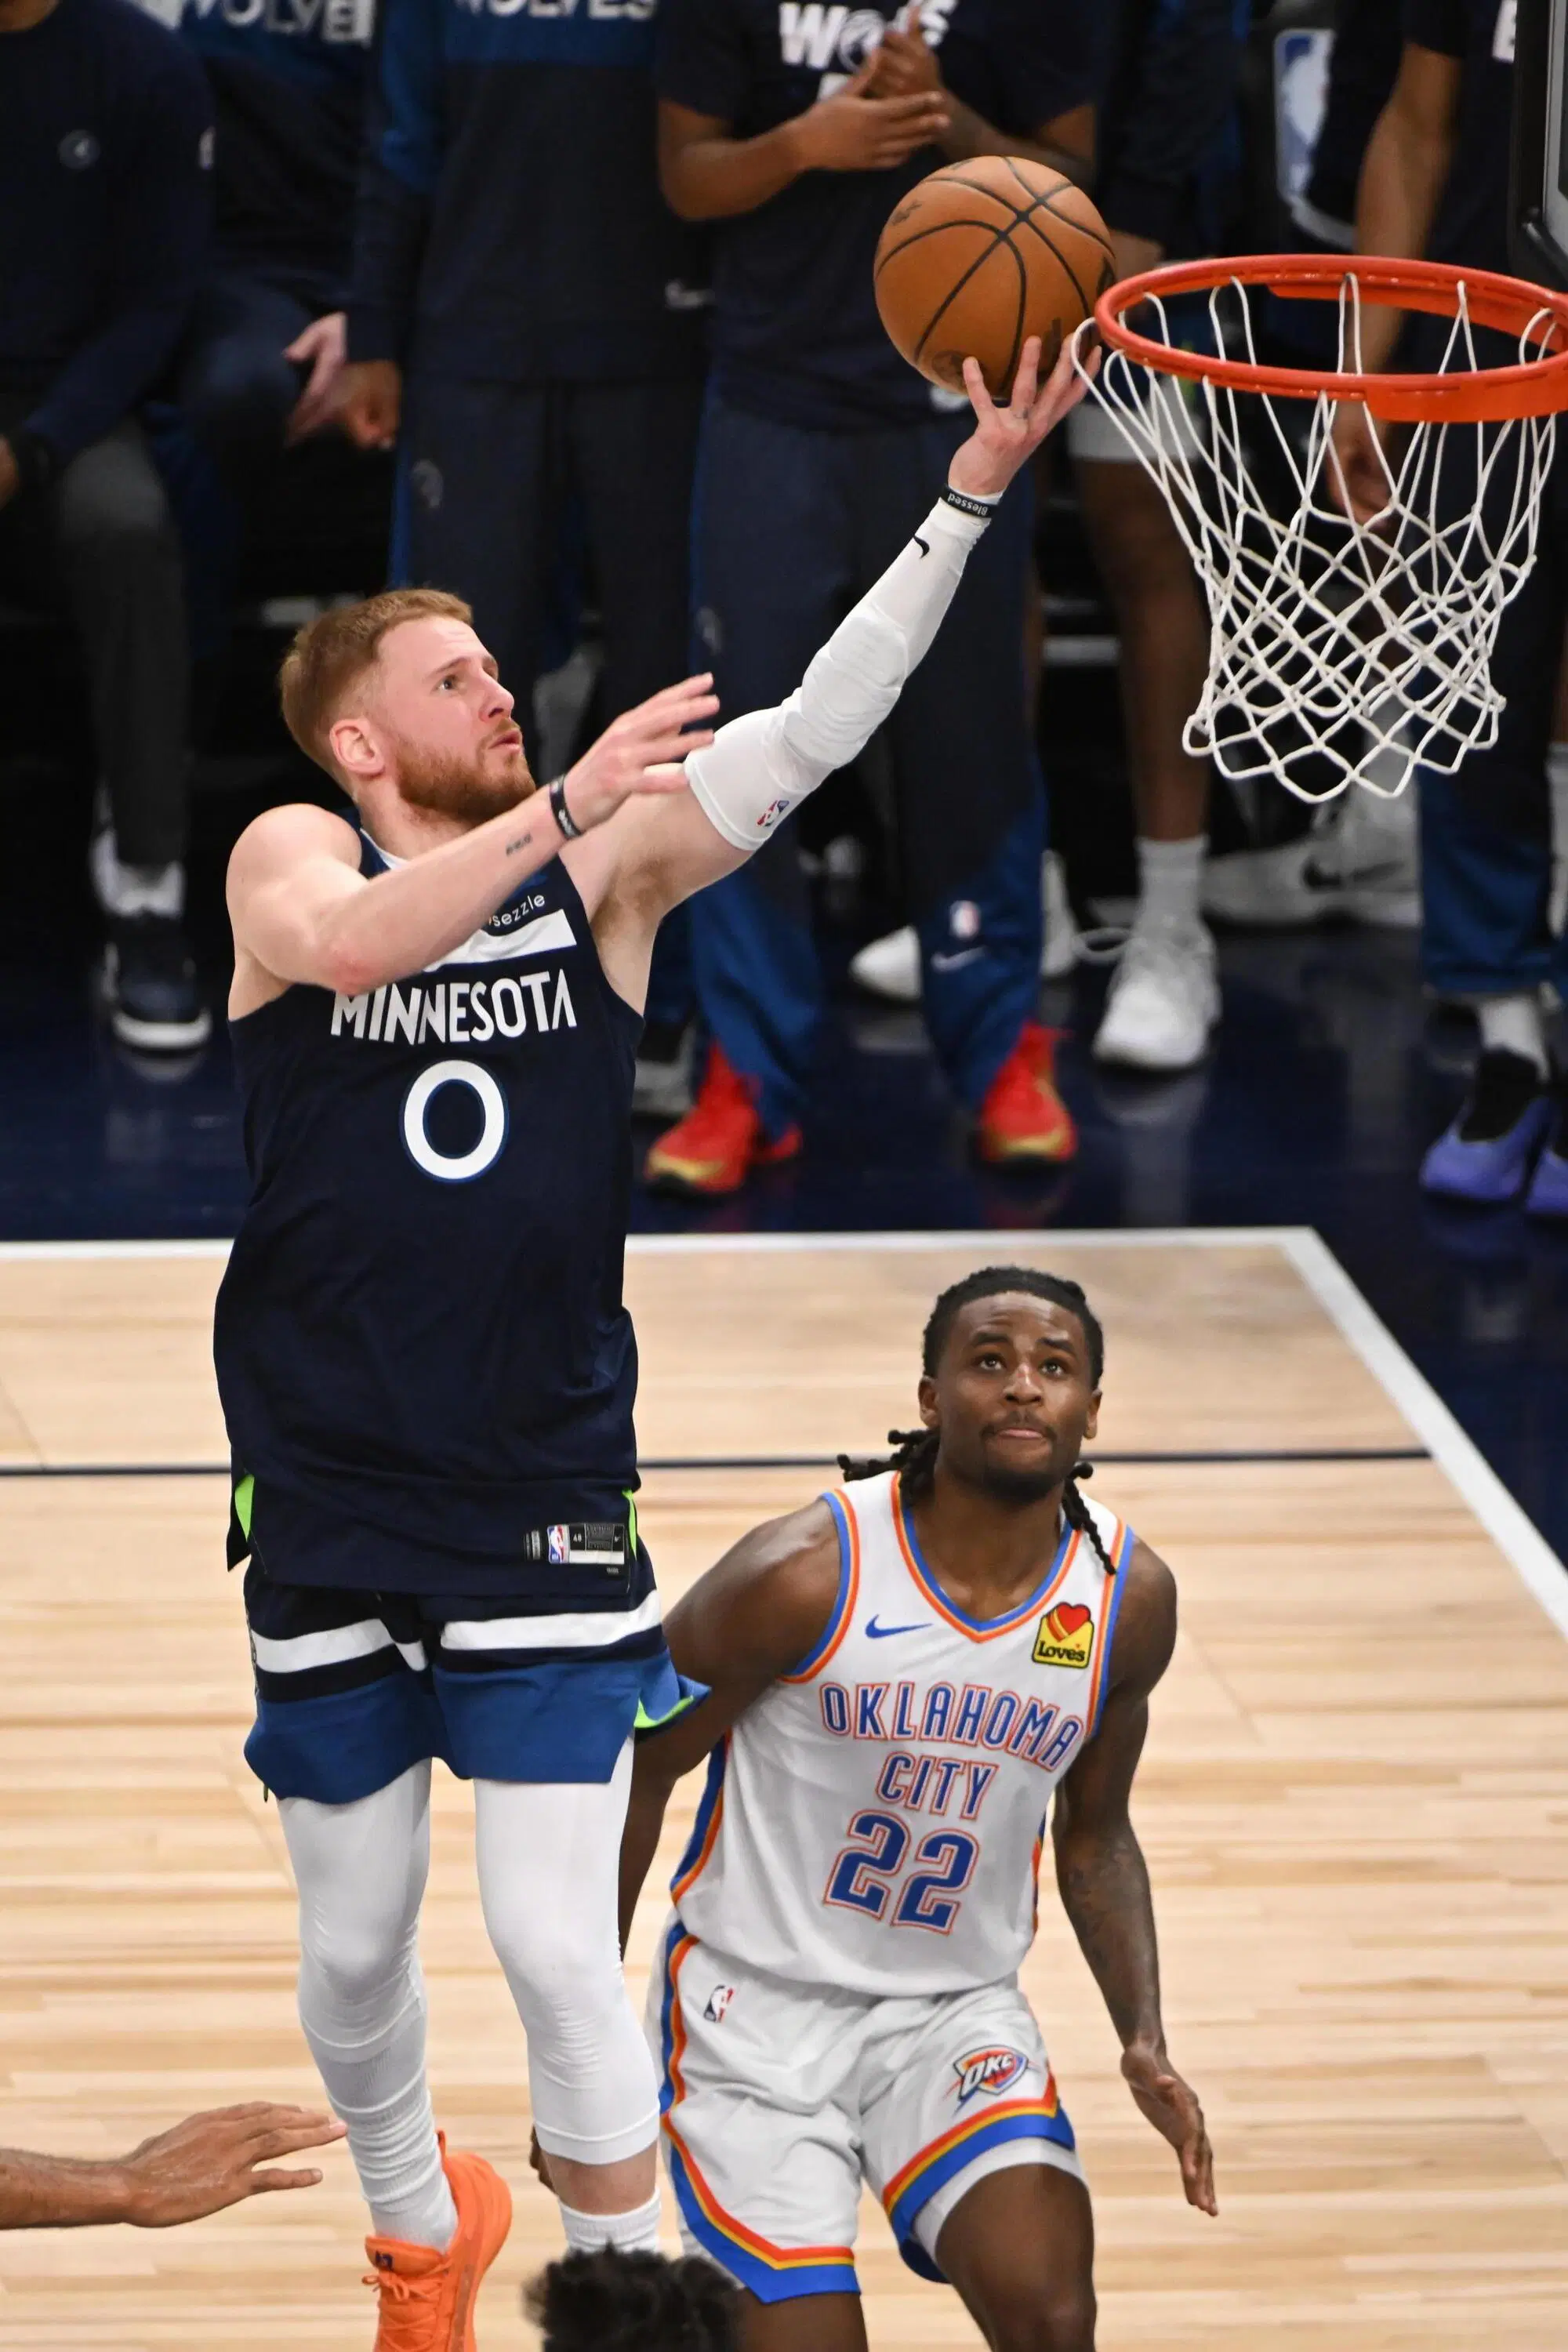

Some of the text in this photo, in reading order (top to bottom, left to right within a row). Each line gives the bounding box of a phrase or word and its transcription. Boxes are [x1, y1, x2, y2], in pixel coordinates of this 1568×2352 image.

[947, 492, 989, 517] Blessed
[492, 895, 545, 927] sezzle
[330, 968, 578, 1046] MINNESOTA
[401, 1058, 510, 1183] 0
[819, 1682, 1084, 1772] OKLAHOMA
[876, 1751, 1000, 1820] CITY
[822, 1808, 980, 1936] 22
